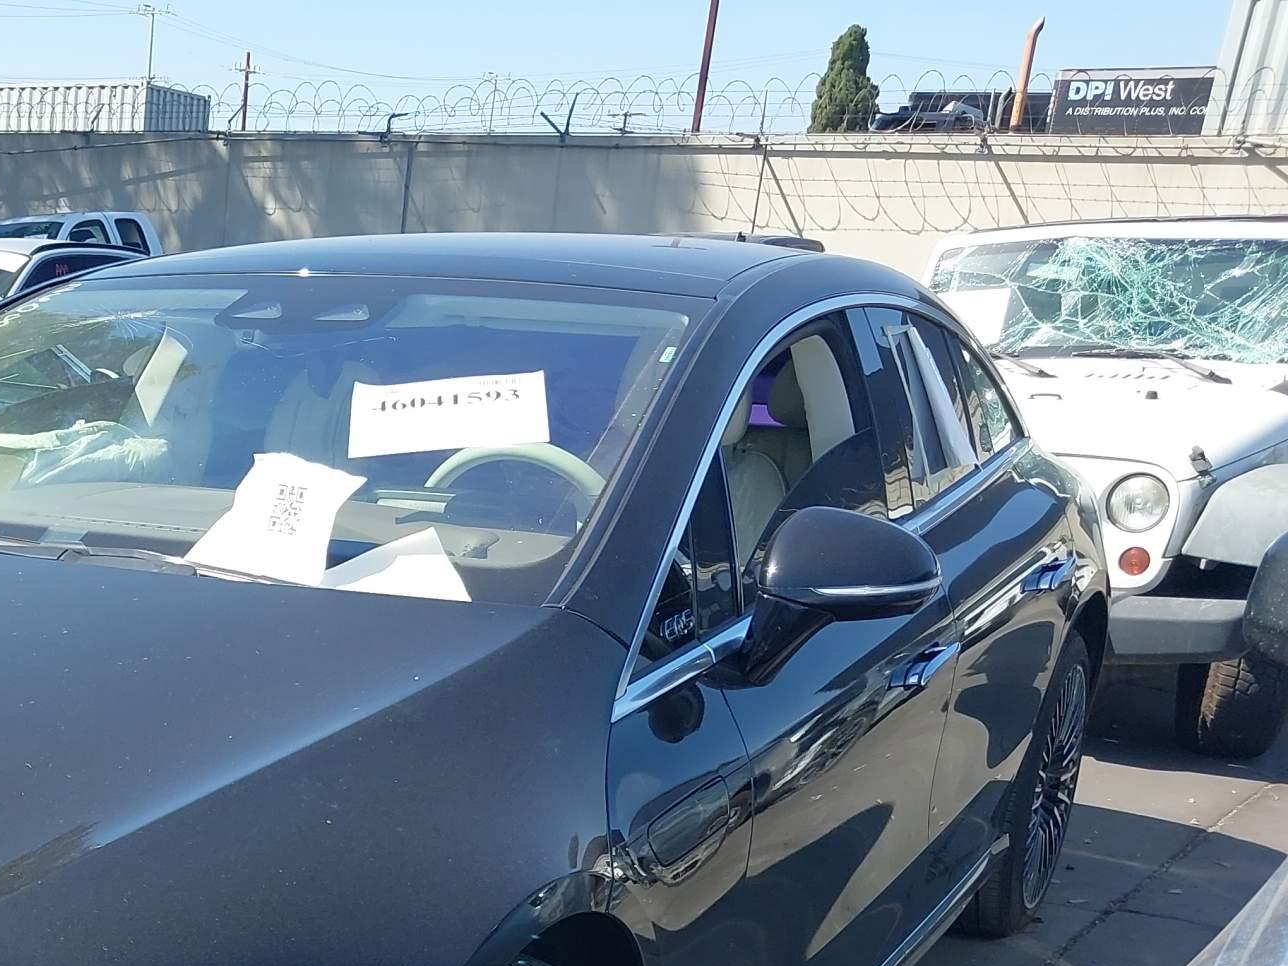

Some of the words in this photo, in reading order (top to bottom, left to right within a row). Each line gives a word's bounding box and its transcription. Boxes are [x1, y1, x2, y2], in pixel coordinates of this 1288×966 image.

[1068, 81, 1114, 101] DPI
[1119, 80, 1175, 101] West
[1066, 107, 1073, 116] A
[1073, 106, 1138, 116] DISTRIBUTION
[371, 388, 520, 412] 46041593
